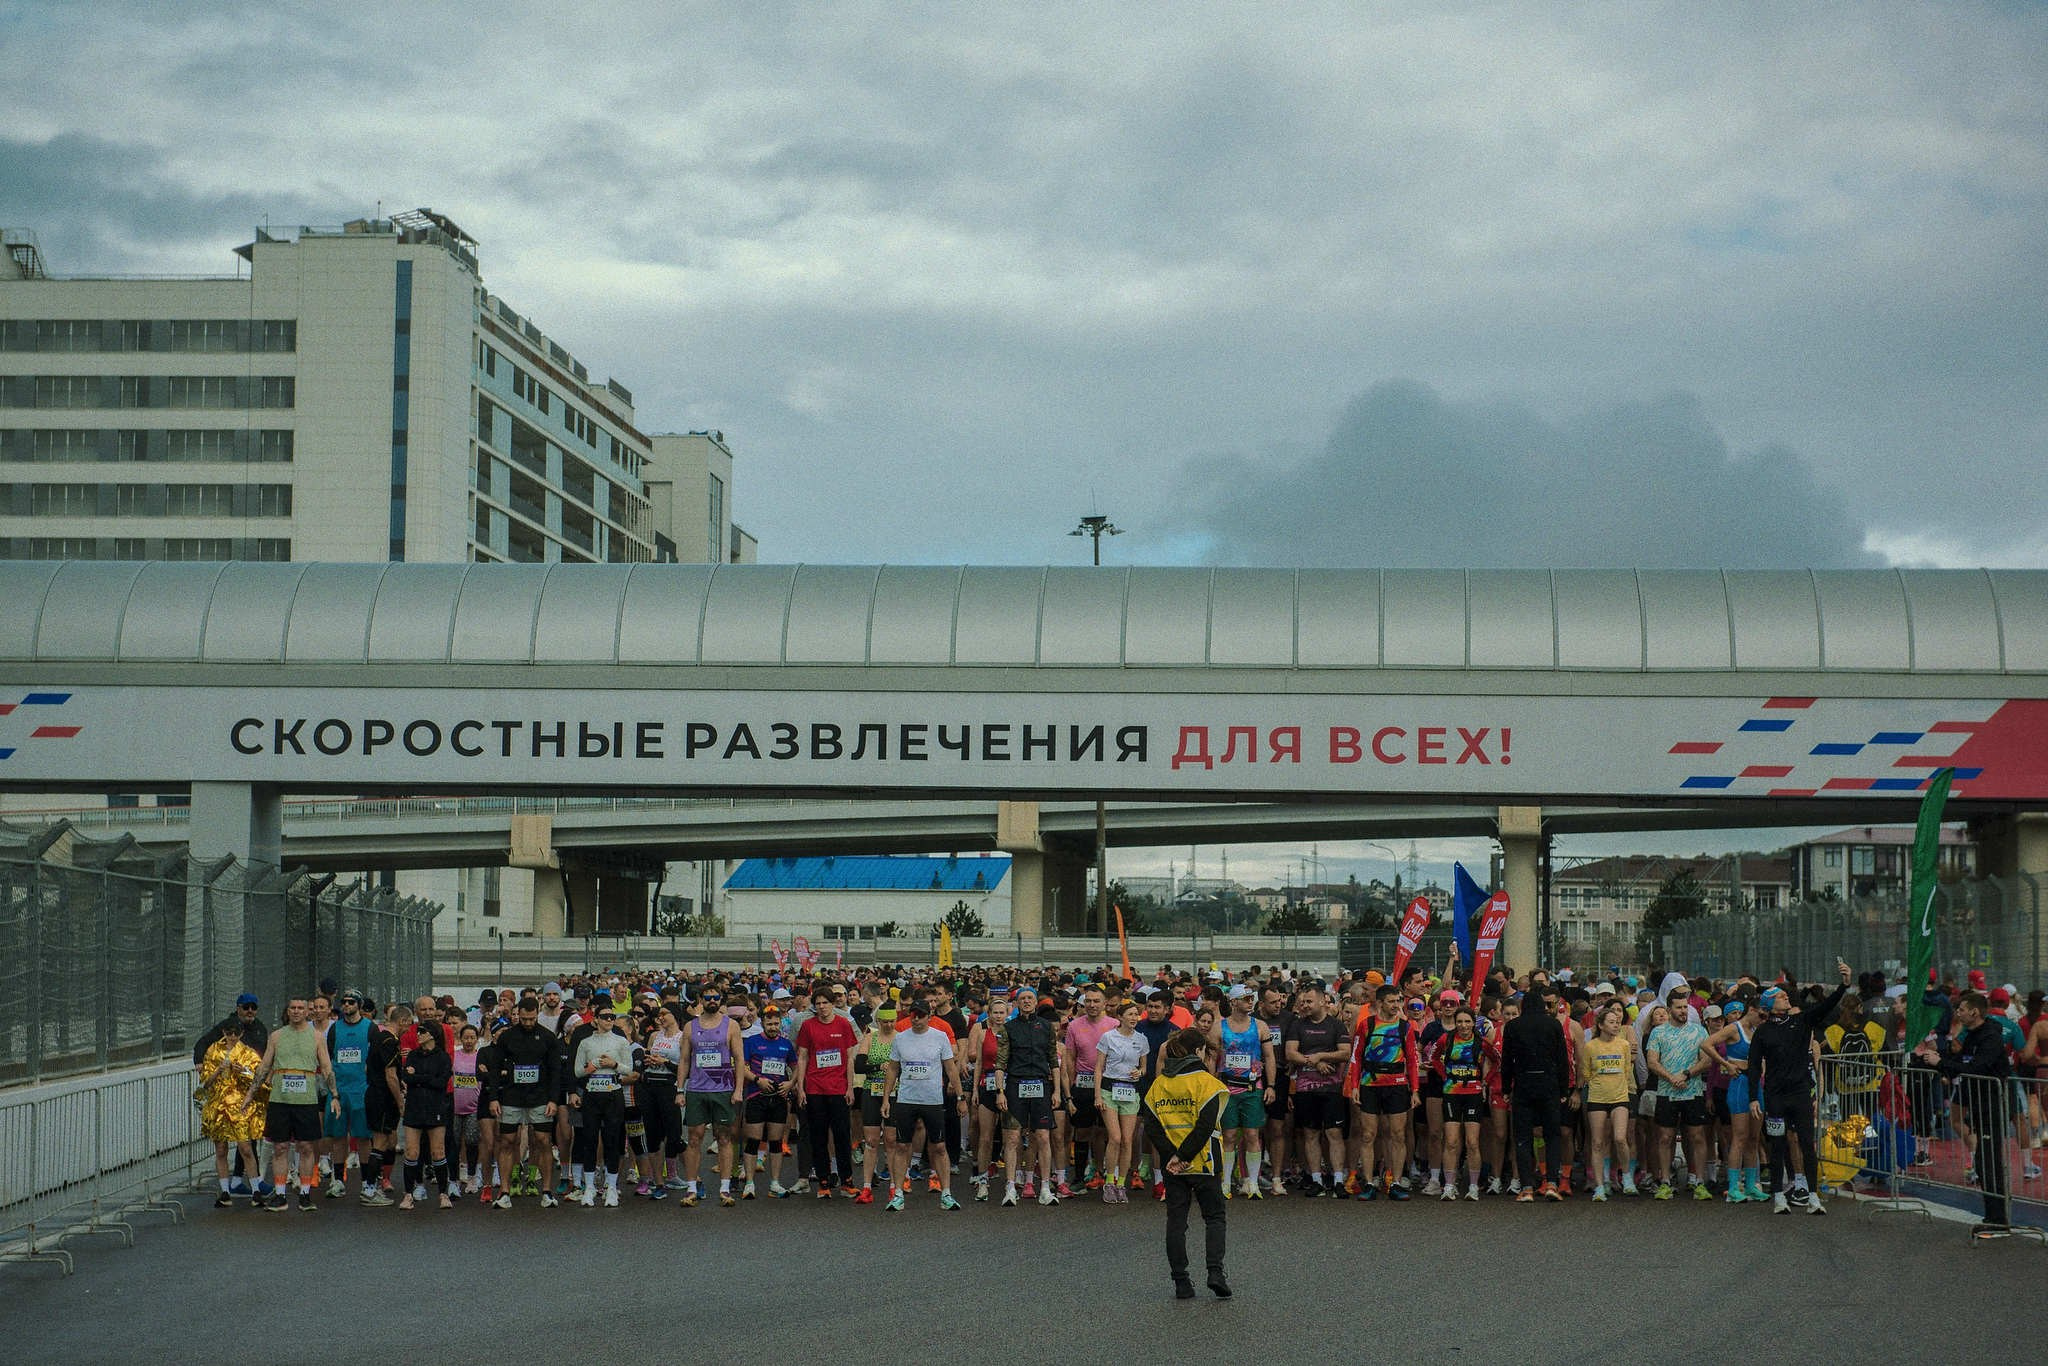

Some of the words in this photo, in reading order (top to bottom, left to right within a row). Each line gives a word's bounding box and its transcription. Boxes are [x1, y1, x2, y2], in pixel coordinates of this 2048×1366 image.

[230, 716, 665, 759] СКОРОСТНЫЕ
[685, 722, 1149, 763] РАЗВЛЕЧЕНИЯ
[1171, 725, 1302, 770] ДЛЯ
[1329, 726, 1512, 766] ВСЕХ!
[820, 1054, 838, 1063] 4287
[909, 1066, 928, 1074] 4815
[1022, 1084, 1041, 1092] 3678
